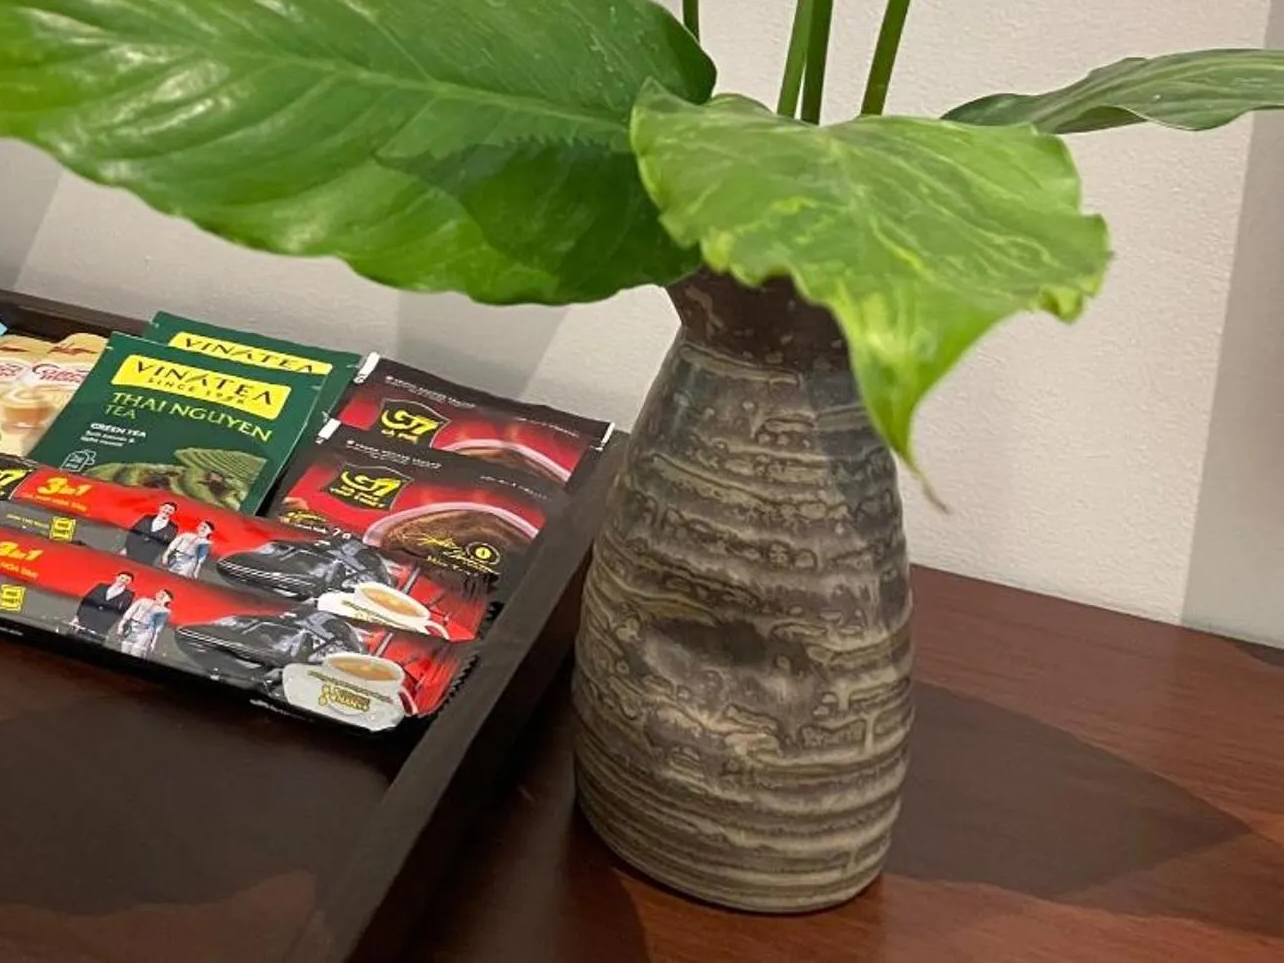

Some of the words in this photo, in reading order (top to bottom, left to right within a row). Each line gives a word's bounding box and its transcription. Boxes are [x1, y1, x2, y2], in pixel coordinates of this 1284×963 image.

[185, 337, 314, 373] VINATEA
[137, 360, 273, 406] VINATEA
[105, 404, 137, 420] TEA
[113, 392, 166, 413] THAI
[168, 402, 273, 443] NGUYEN
